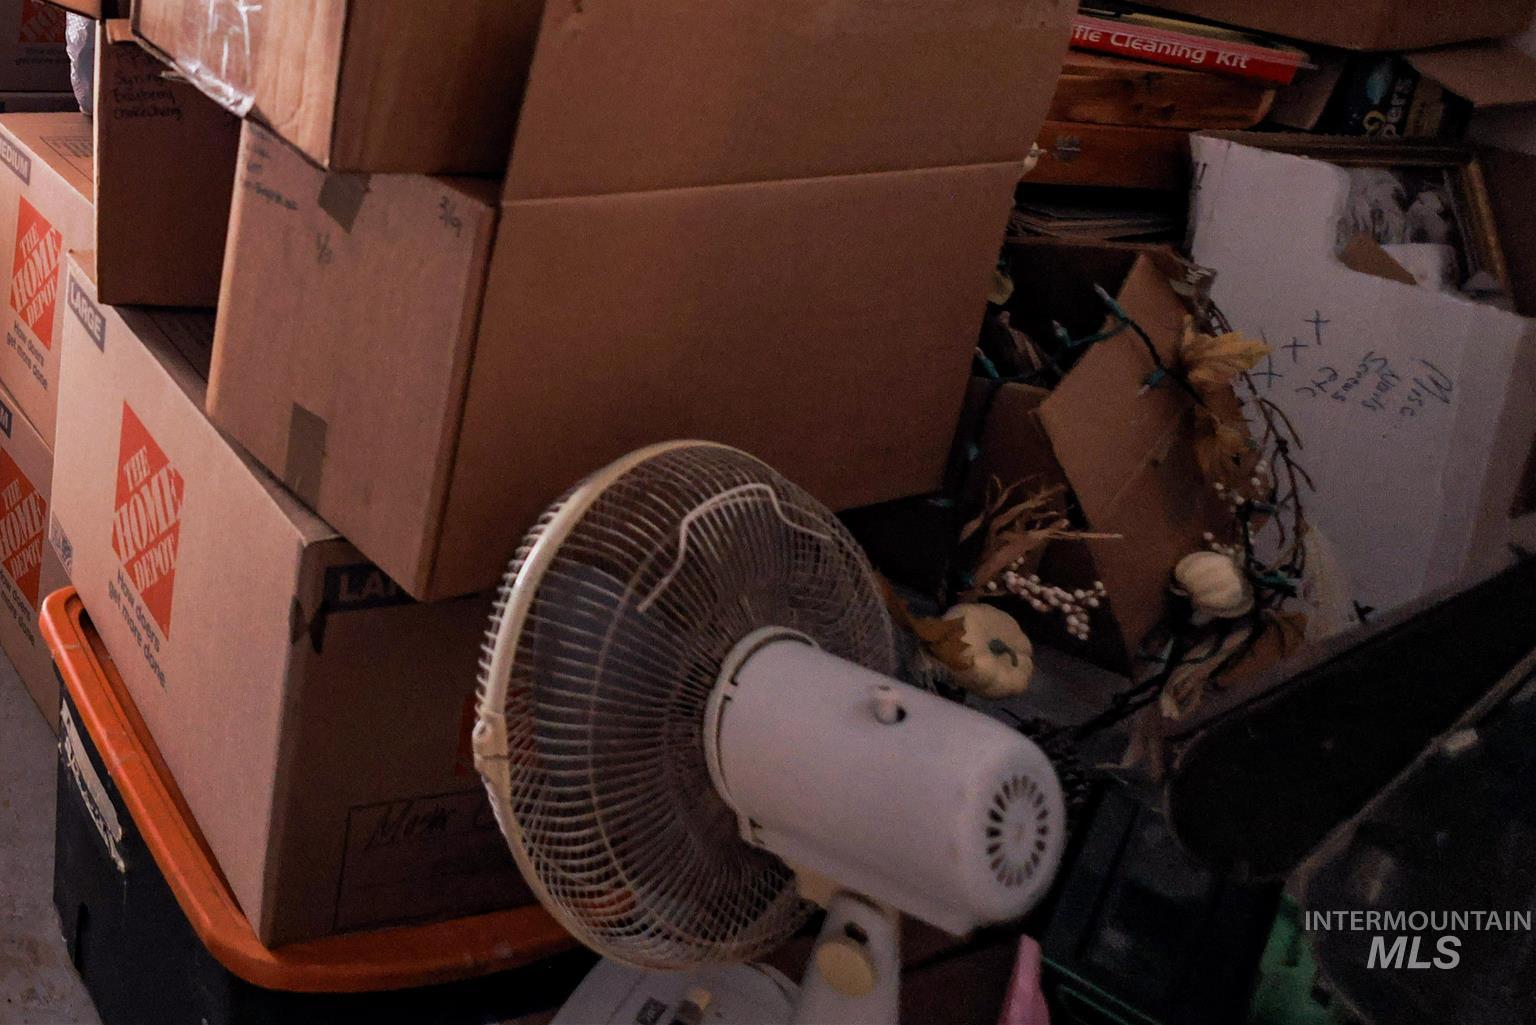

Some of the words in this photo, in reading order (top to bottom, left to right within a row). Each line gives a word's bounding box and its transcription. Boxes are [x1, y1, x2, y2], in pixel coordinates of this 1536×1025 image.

[1110, 32, 1207, 63] Cleaning
[1216, 50, 1249, 68] Kit
[20, 223, 40, 260] THE
[11, 226, 62, 314] HOME
[26, 278, 58, 328] DEPOT
[70, 280, 103, 342] LARGE
[1, 477, 23, 511] THE
[124, 446, 151, 491] THE
[113, 465, 182, 564] HOME
[10, 539, 43, 581] DEPOT
[132, 532, 177, 592] DEPOT
[108, 579, 122, 609] get
[121, 603, 143, 648] more
[117, 567, 136, 608] How
[135, 604, 162, 654] doers
